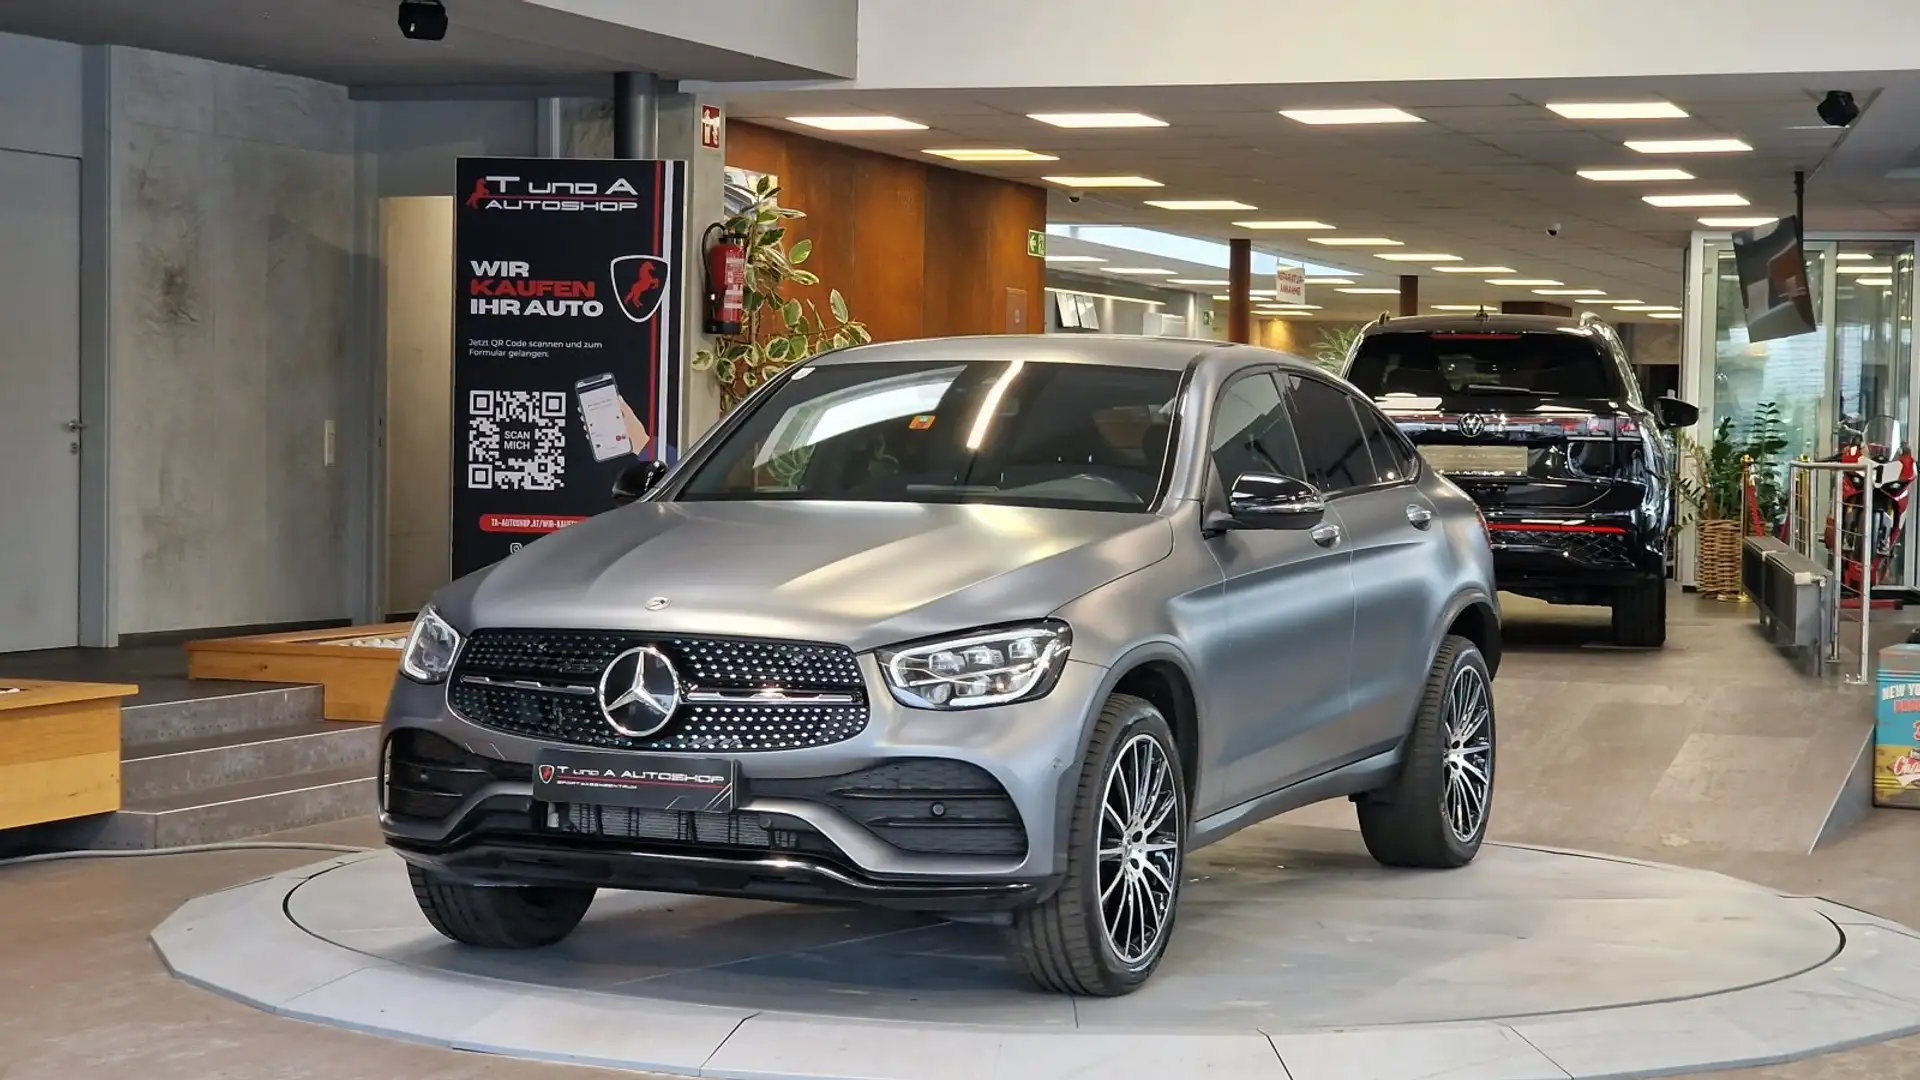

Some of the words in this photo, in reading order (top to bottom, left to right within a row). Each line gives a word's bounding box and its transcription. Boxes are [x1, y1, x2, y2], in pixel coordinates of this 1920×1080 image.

[485, 175, 520, 193] T
[605, 177, 638, 196] A
[485, 200, 638, 212] AUTOSHOP
[470, 260, 530, 277] WIR
[470, 279, 596, 298] KAUFEN
[470, 298, 521, 316] IHR
[523, 299, 604, 317] AUTO
[468, 338, 489, 347] Jetzt
[490, 339, 504, 347] QR
[505, 339, 527, 348] Code
[528, 340, 564, 348] scannen
[565, 340, 582, 349] und
[584, 341, 603, 349] zum
[469, 348, 506, 357] Formular
[508, 348, 550, 359] gelangen.
[504, 430, 530, 440] SCAN
[504, 440, 530, 450] MICH
[1882, 683, 1906, 700] NEW
[556, 765, 569, 774] T
[603, 769, 616, 777] A
[620, 770, 725, 784] AUTOSHOP
